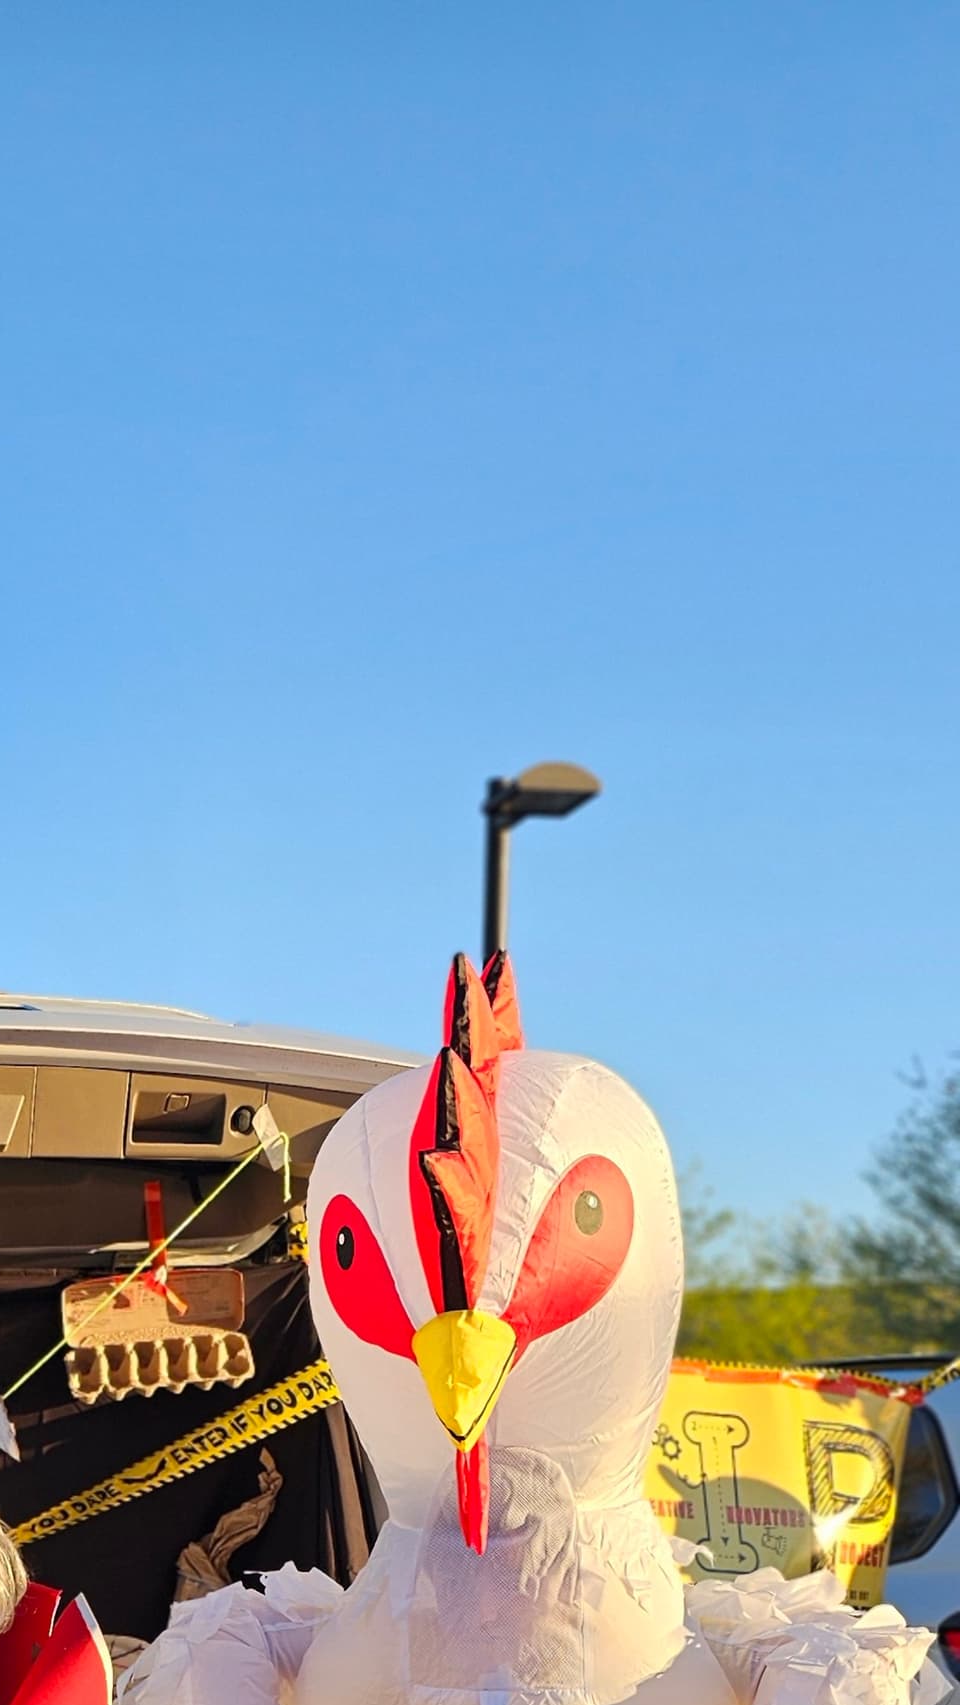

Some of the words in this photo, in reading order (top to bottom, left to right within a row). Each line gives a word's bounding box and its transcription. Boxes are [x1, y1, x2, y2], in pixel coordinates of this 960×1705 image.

[30, 1508, 69, 1533] YOU
[76, 1483, 122, 1514] DARE
[170, 1426, 232, 1466] ENTER
[228, 1413, 249, 1438] IF
[251, 1388, 297, 1422] YOU
[297, 1369, 337, 1401] DAR
